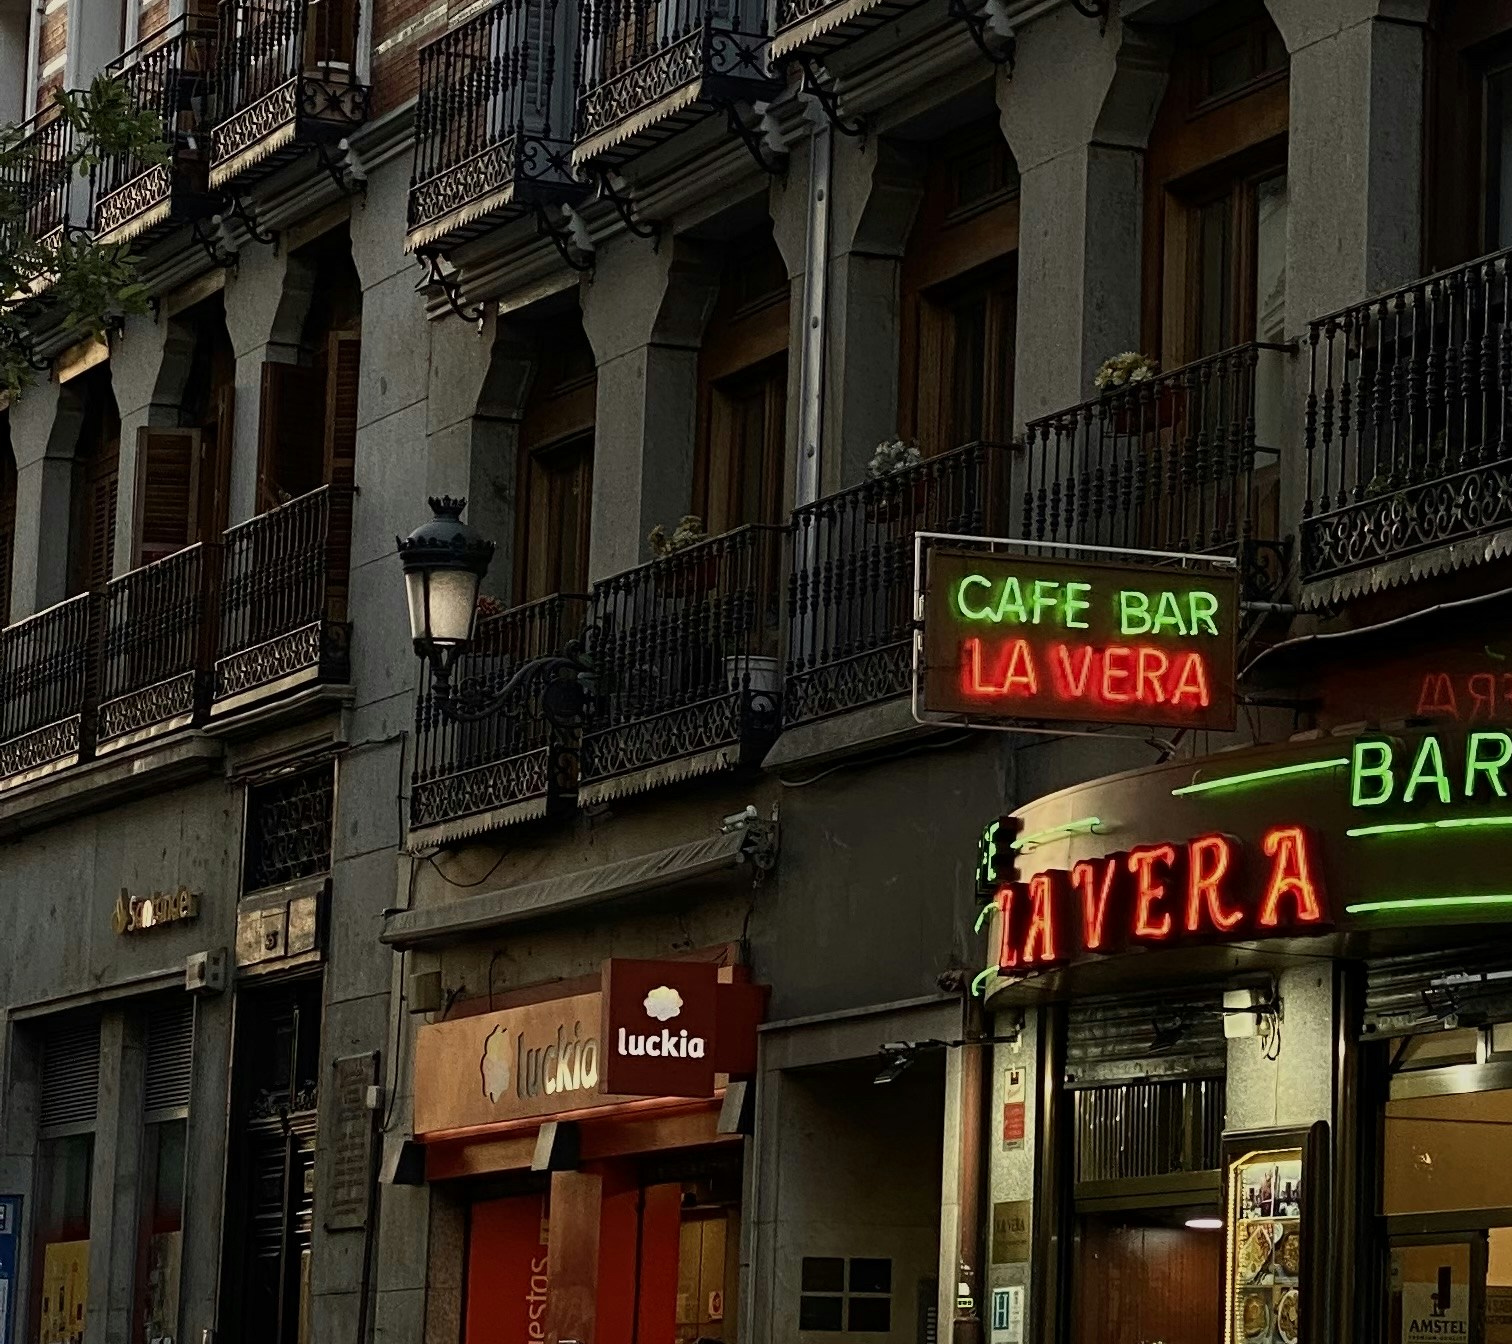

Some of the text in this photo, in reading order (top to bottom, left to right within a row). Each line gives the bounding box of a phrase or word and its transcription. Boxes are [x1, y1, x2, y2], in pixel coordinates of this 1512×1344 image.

[957, 574, 1219, 636] CAFE BAR
[967, 638, 1210, 707] LA VERA
[1352, 731, 1512, 807] BAR
[998, 872, 1056, 969] LA
[1072, 825, 1322, 949] VERA
[516, 1020, 599, 1100] luckia
[618, 1027, 706, 1058] luckia
[1409, 1319, 1467, 1334] AMSTEL
